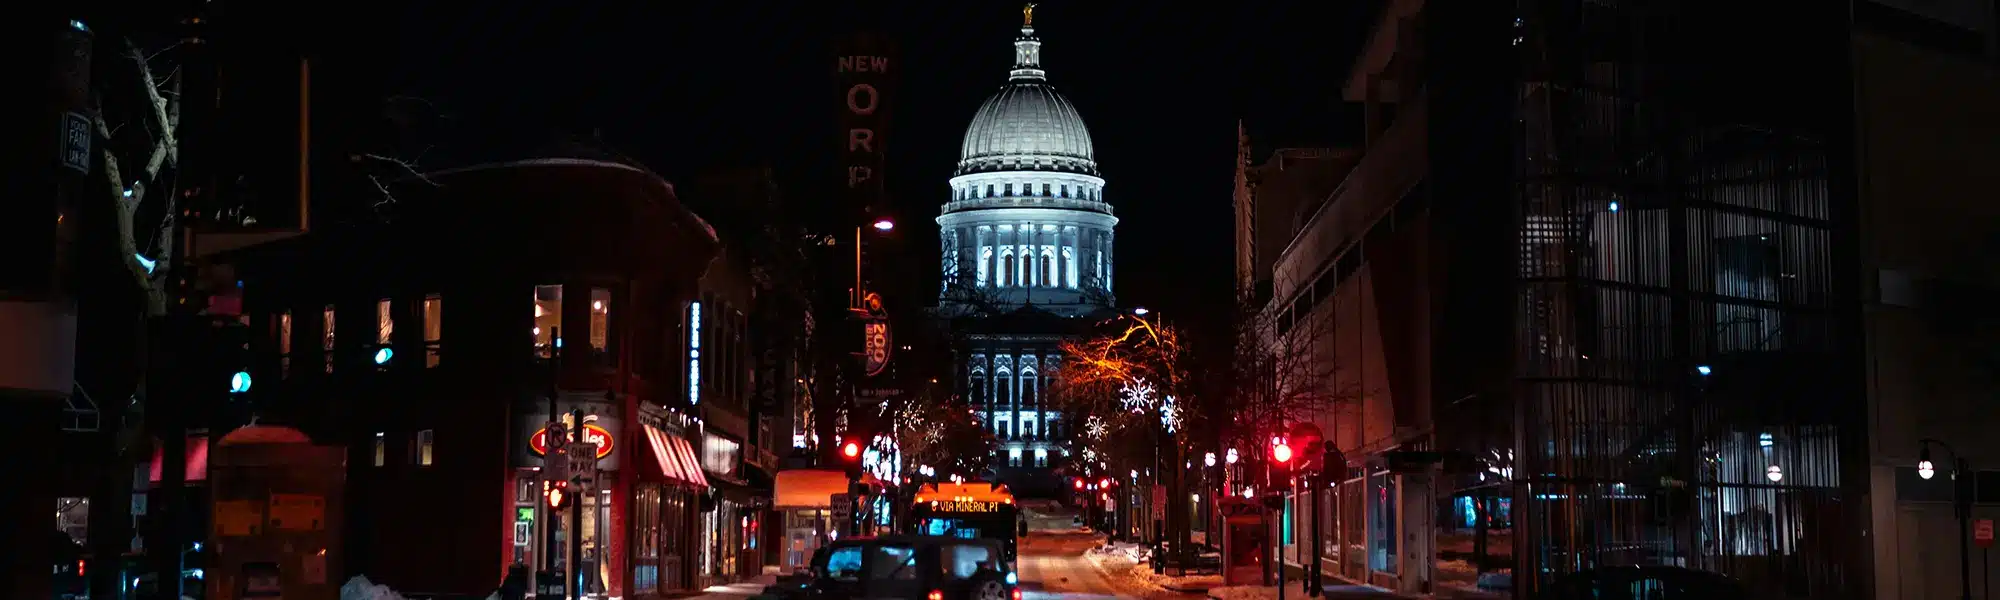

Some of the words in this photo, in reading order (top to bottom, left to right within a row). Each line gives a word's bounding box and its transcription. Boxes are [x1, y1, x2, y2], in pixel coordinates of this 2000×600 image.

[838, 55, 889, 75] NEW
[874, 324, 885, 363] 200
[571, 448, 593, 458] ONE
[570, 461, 593, 472] WAY
[940, 501, 954, 512] VIA
[956, 501, 987, 512] MINERAL
[989, 501, 998, 512] PT
